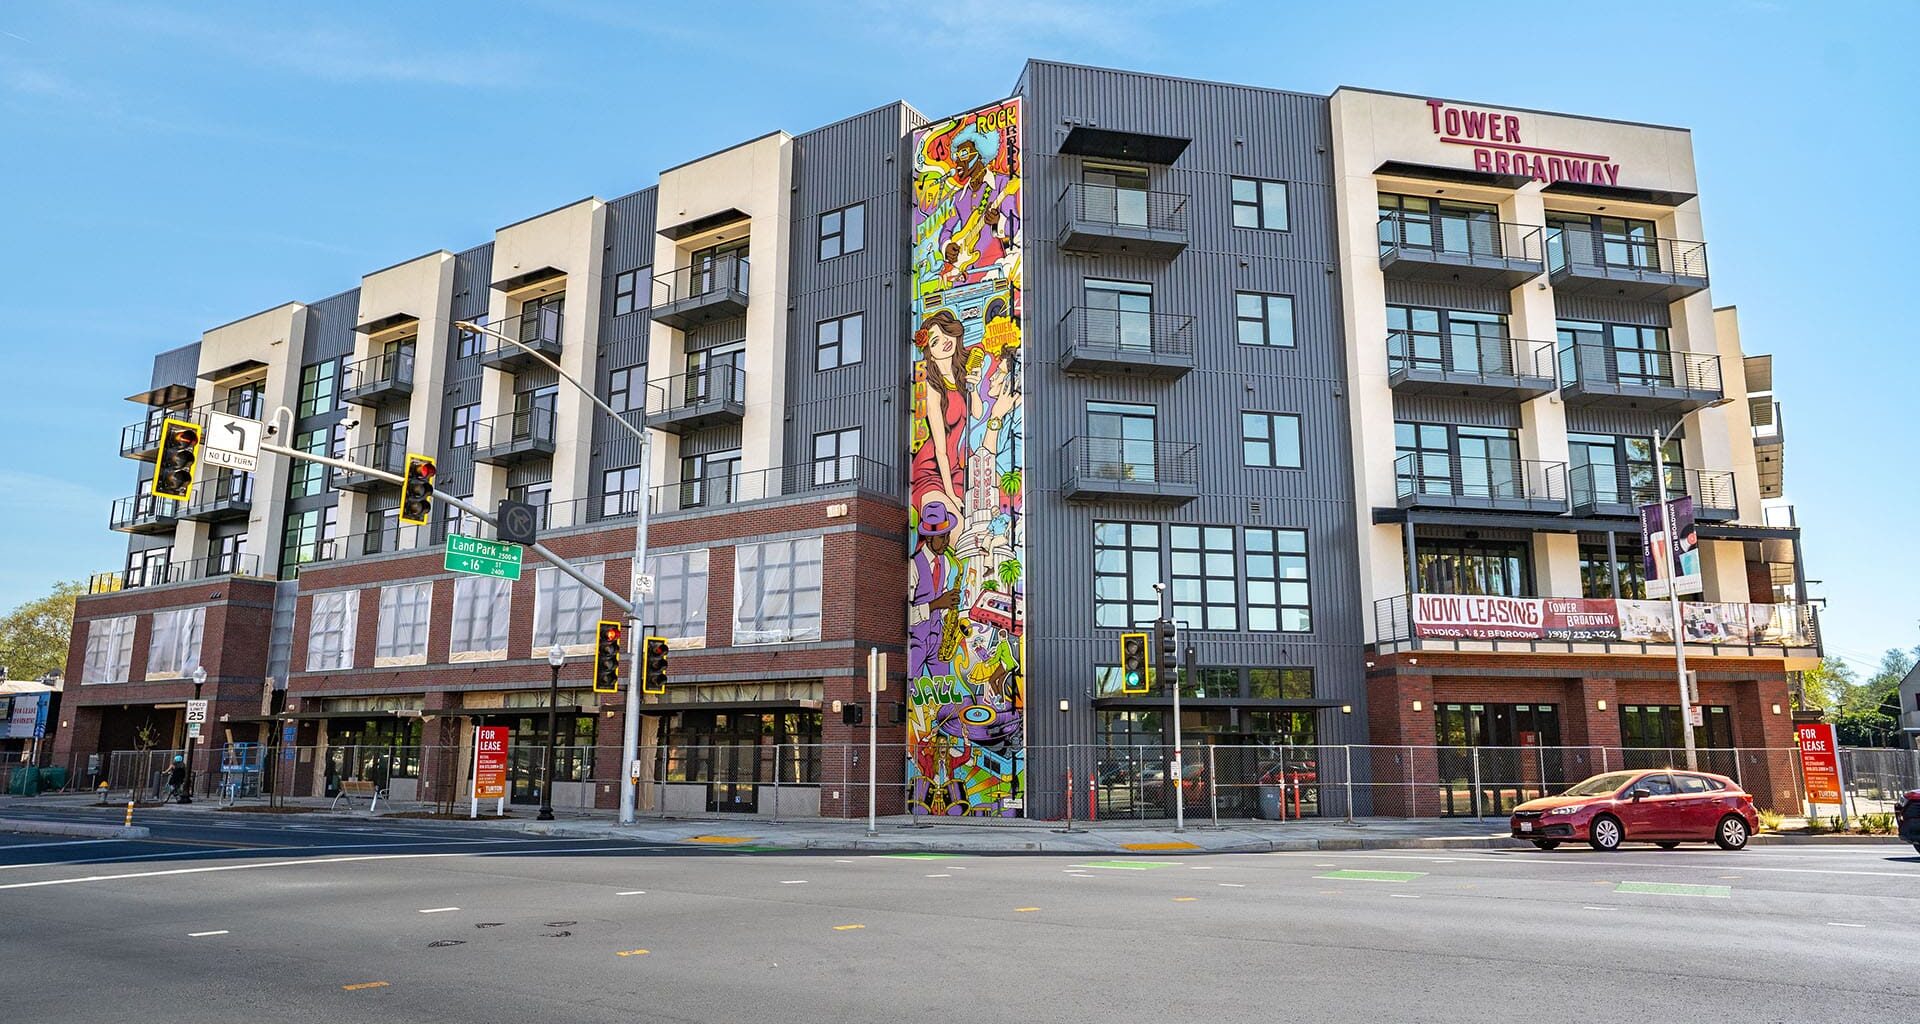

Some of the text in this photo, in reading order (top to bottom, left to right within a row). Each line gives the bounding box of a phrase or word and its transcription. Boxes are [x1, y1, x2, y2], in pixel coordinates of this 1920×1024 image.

[976, 105, 1017, 134] ROCK
[1427, 100, 1521, 143] TOWER
[1474, 149, 1620, 187] BROADWAY
[988, 320, 1012, 336] TOWER
[985, 332, 1018, 350] RECORDS
[915, 361, 927, 440] SOUL
[209, 451, 252, 467] NO U TURN
[1641, 509, 1650, 546] BROADWAY
[1668, 503, 1679, 540] BROADWAY
[453, 538, 497, 556] Land Park
[470, 558, 484, 570] 16
[1419, 597, 1538, 625] NOW LEASING
[1547, 601, 1577, 613] TOWER
[1566, 614, 1615, 627] BROADWAY
[911, 675, 963, 706] JAZZ
[189, 711, 204, 720] 25
[481, 730, 495, 739] FOR
[1801, 728, 1816, 739] FOR
[480, 741, 502, 751] LEASE
[1802, 741, 1826, 751] LEASE
